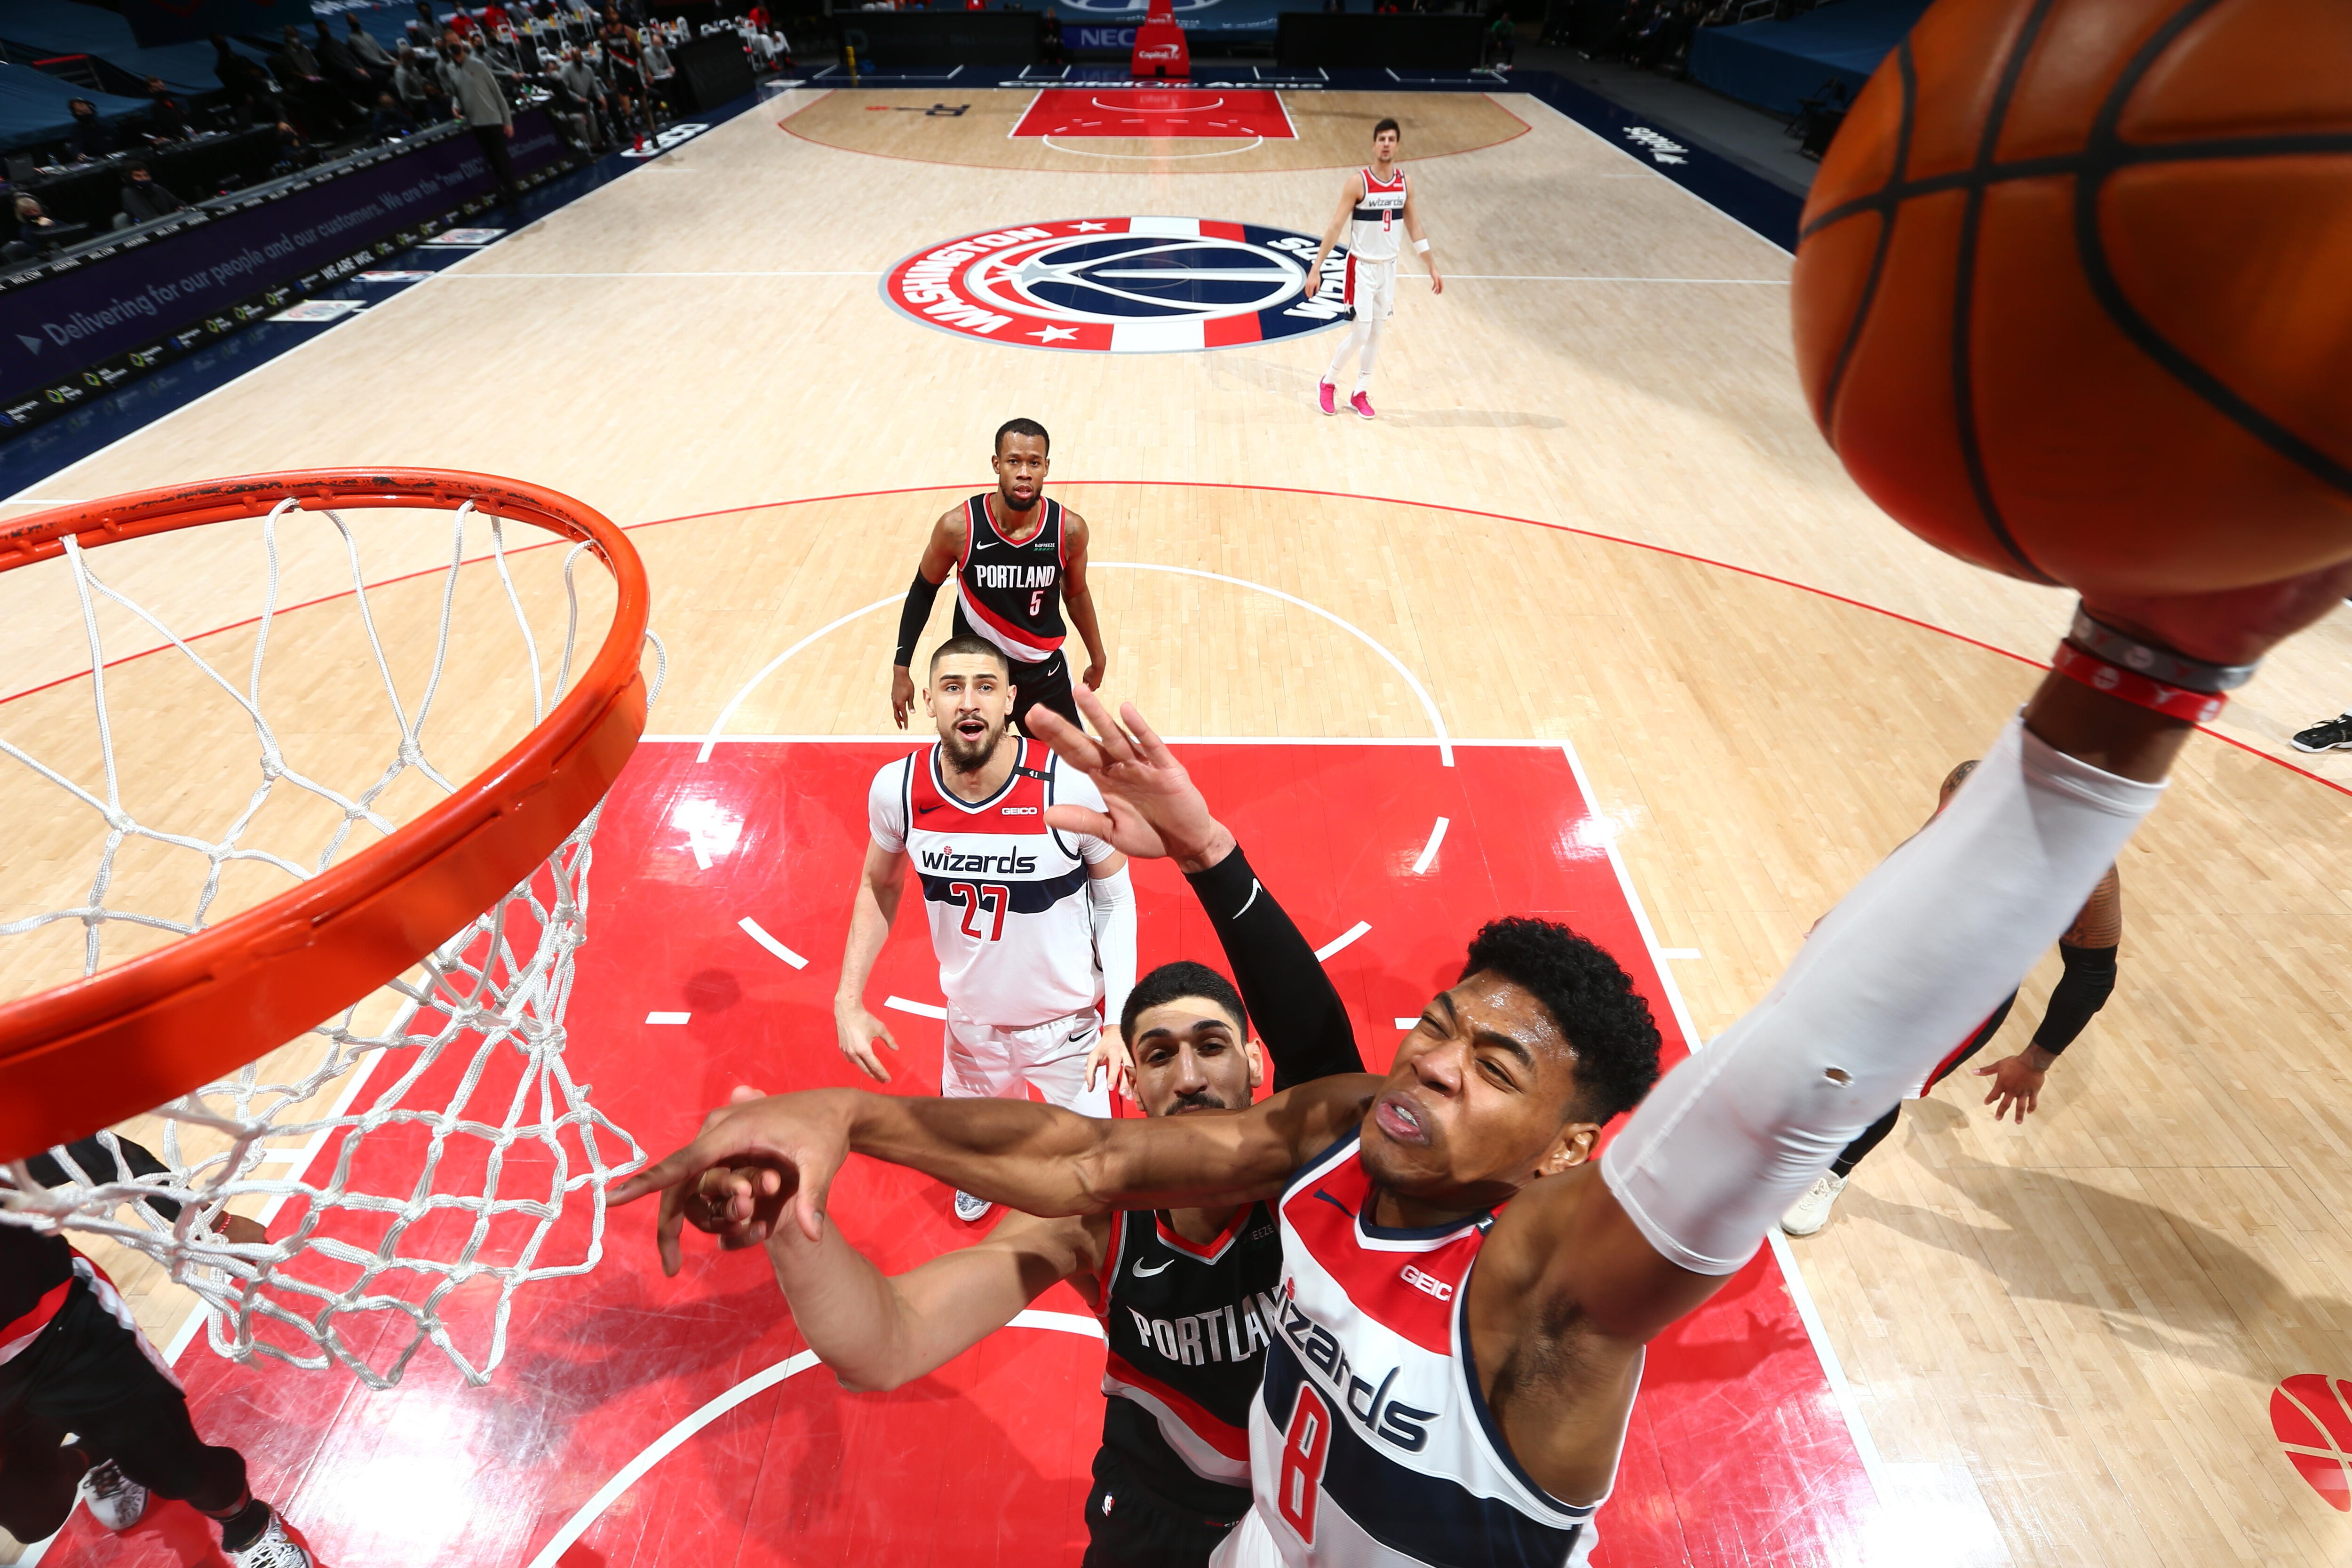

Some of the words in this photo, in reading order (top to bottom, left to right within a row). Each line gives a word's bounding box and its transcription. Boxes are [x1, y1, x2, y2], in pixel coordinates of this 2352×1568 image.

[1081, 28, 1135, 46] NEC
[1369, 196, 1404, 207] wizards
[1382, 209, 1392, 232] 9
[42, 294, 158, 346] Delivering
[146, 283, 181, 304] for
[180, 271, 212, 293] our
[210, 246, 266, 286] people
[263, 231, 296, 261] and
[293, 228, 319, 247] our
[318, 203, 385, 237] customers.
[378, 191, 404, 210] We
[401, 187, 423, 203] are
[320, 264, 338, 281] WE
[335, 257, 357, 275] ARE
[352, 249, 376, 266] WGL
[902, 227, 1053, 334] WASHINGTON
[974, 565, 1056, 589] PORTLAND
[1029, 590, 1044, 616] 5
[922, 845, 1038, 874] wizards
[949, 882, 1010, 942] 27
[1400, 1264, 1454, 1303] GEIC
[1126, 1286, 1280, 1366] PORTLAN
[1277, 1274, 1444, 1455] izards
[1278, 1379, 1333, 1551] 8
